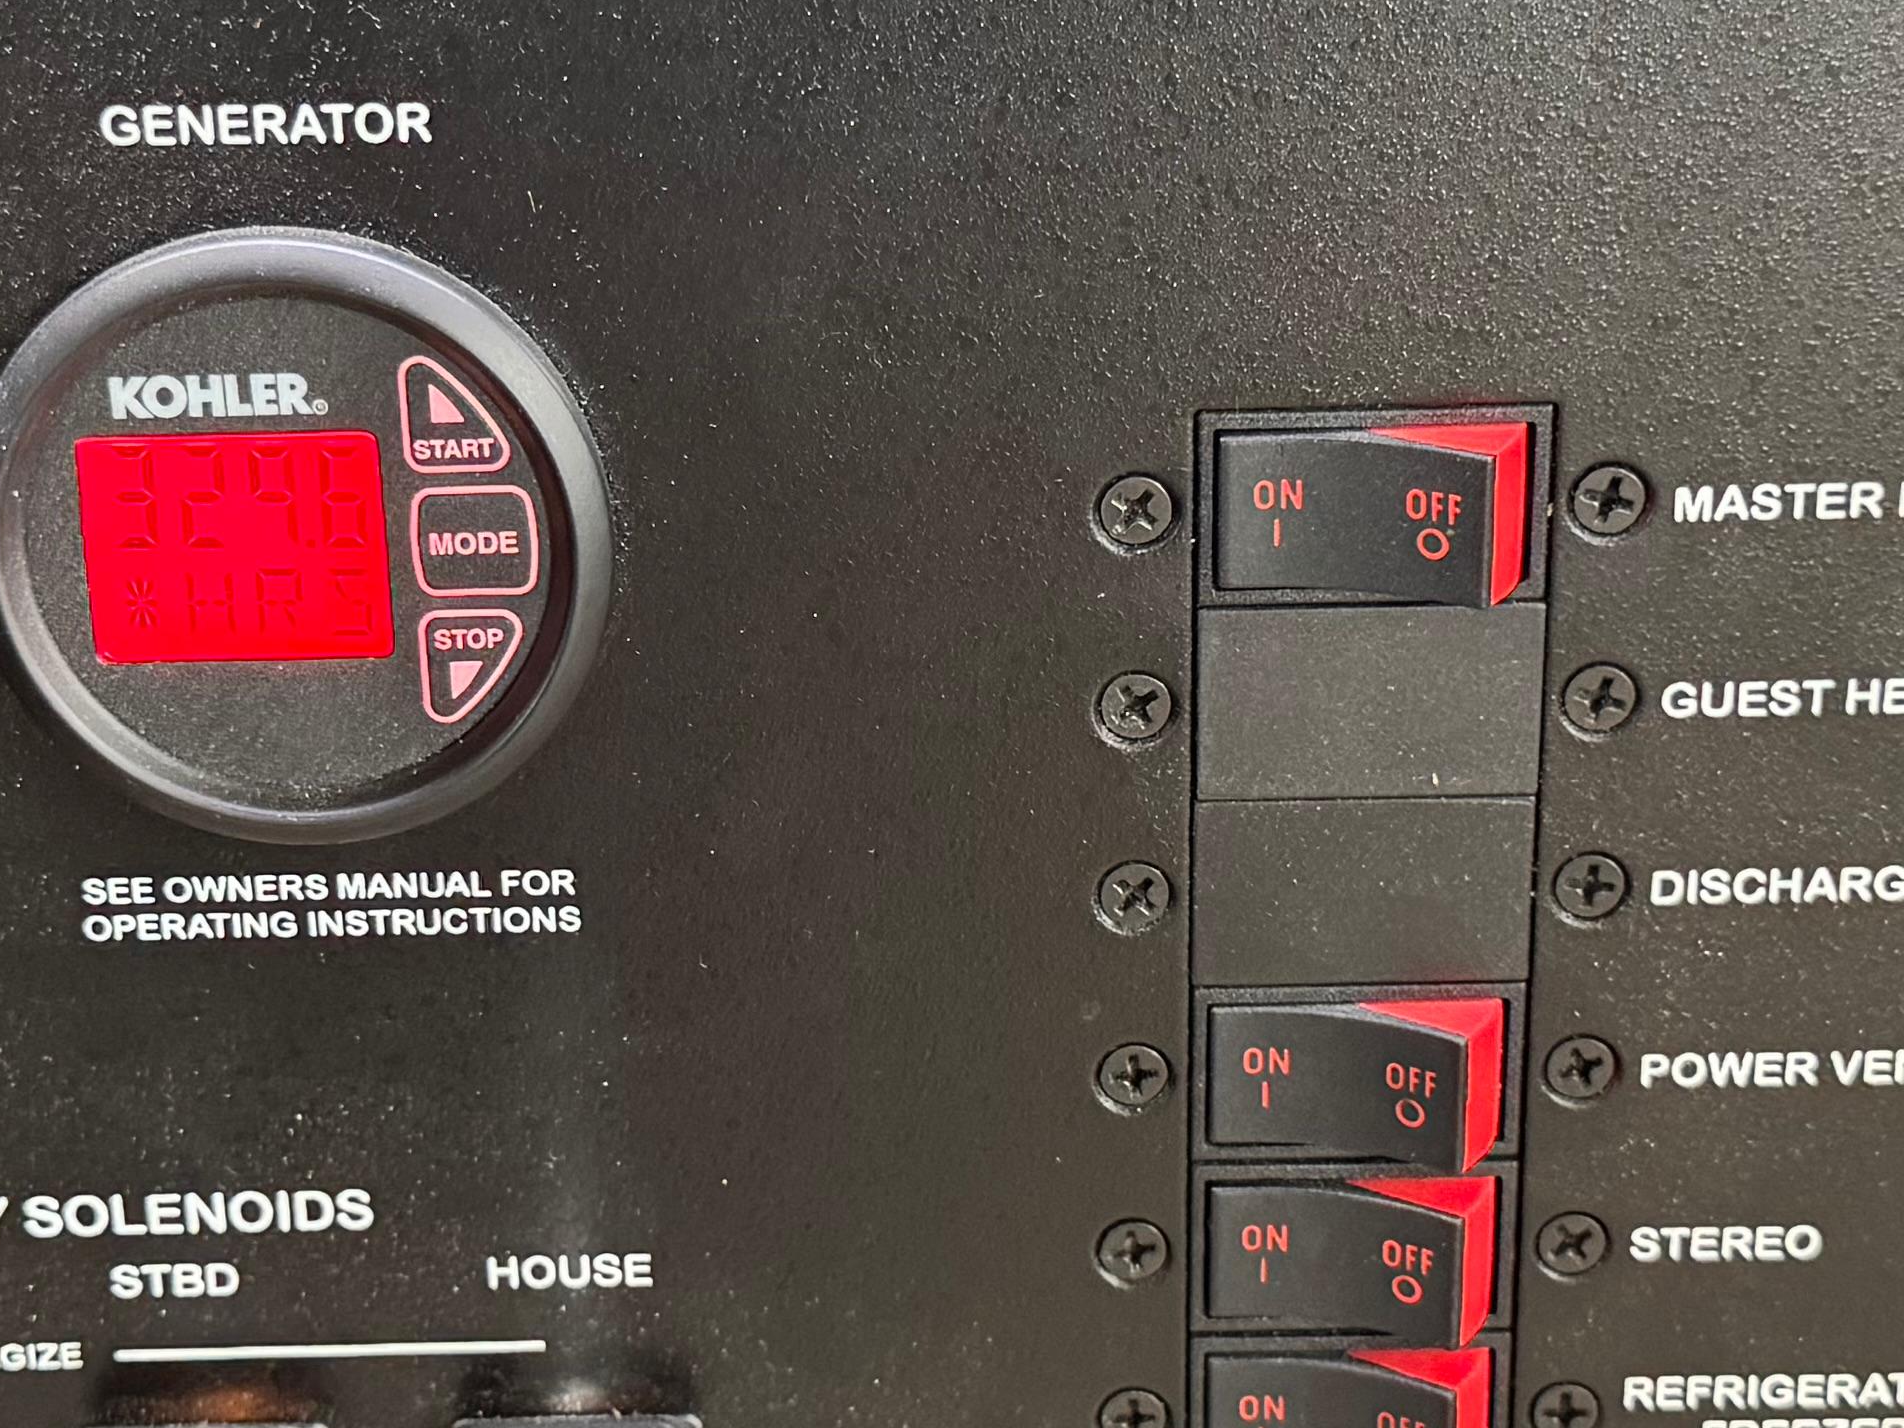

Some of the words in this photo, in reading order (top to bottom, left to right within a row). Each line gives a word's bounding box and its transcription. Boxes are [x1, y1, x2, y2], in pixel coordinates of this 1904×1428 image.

[99, 101, 432, 147] GENERATOR
[412, 437, 495, 460] START
[1253, 479, 1305, 511] ON
[1405, 489, 1462, 525] OFF
[1674, 481, 1885, 523] MASTER
[428, 530, 519, 556] MODE
[433, 627, 504, 651] STOP
[1661, 679, 1836, 719] GUEST
[82, 876, 156, 906] SEE
[162, 873, 329, 904] OWNERS
[336, 870, 492, 900] MANUAL
[500, 869, 576, 897] FOR
[82, 910, 298, 942] OPERATING
[307, 905, 582, 937] INSTRUCTIONS
[1243, 1047, 1292, 1076] ON
[1640, 1051, 1819, 1088] POWER
[1386, 1062, 1436, 1098] OFF
[22, 1188, 374, 1238] SOLENOIDS
[1242, 1224, 1290, 1253] ON
[1629, 1224, 1822, 1262] STEREO
[486, 1253, 653, 1290] HOUSE
[1382, 1239, 1433, 1275] OFF
[110, 1262, 240, 1299] STBD
[1239, 1395, 1286, 1423] ON
